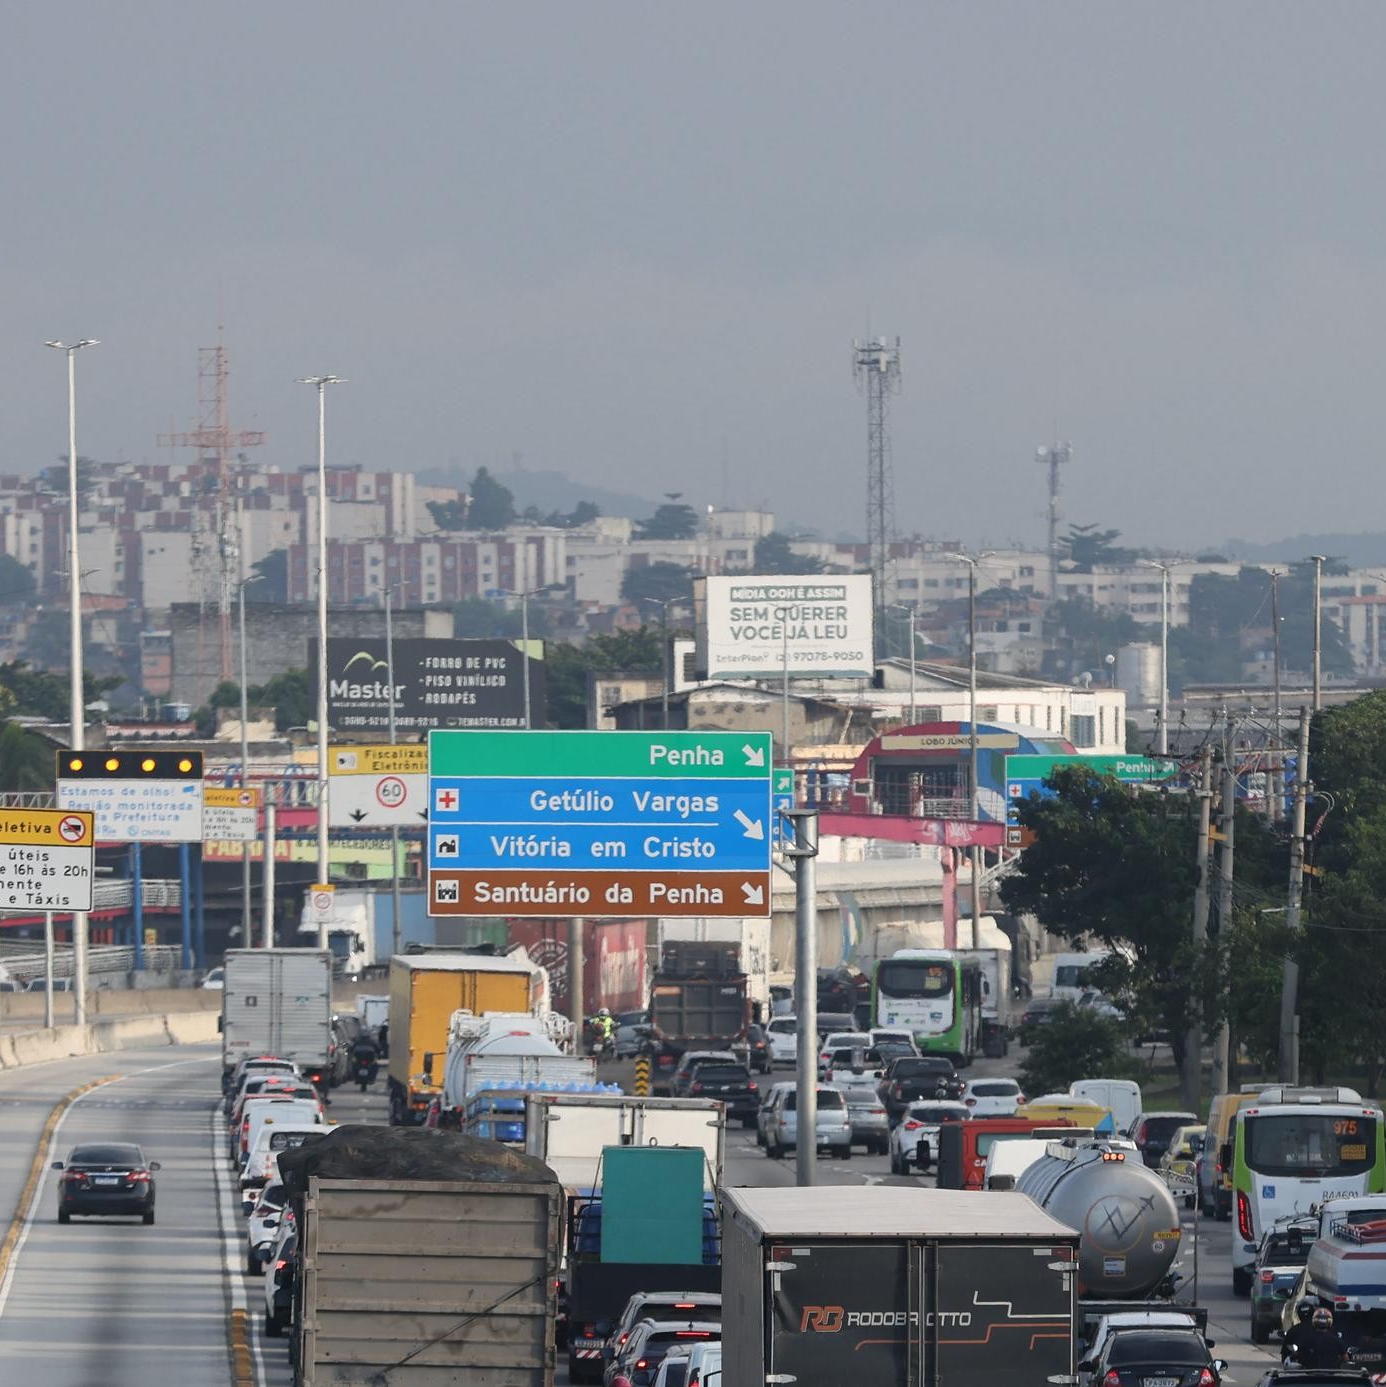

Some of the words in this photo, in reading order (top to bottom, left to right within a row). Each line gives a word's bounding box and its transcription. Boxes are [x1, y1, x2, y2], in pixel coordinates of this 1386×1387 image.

[806, 587, 845, 599] ASSIM
[730, 607, 768, 622] SEM
[774, 605, 848, 623] QUERER
[729, 622, 783, 640] VOCÊ
[786, 622, 810, 640] JÁ
[814, 625, 848, 640] LEU
[466, 657, 481, 669] DE
[484, 657, 507, 669] PVC
[329, 679, 406, 700] Master
[921, 738, 946, 746] LOBO
[650, 744, 725, 766] Penha
[121, 786, 136, 796] de
[382, 785, 402, 798] 60
[117, 801, 194, 811] monitorada
[530, 789, 615, 812] Getúlio
[632, 790, 720, 819] Vargas
[113, 812, 181, 822] Prefeitura
[490, 833, 571, 858] Vitória
[590, 839, 627, 858] em
[643, 836, 716, 859] Cristo
[8, 848, 50, 862] úteis
[0, 866, 6, 875] e
[14, 863, 34, 876] 16h
[41, 864, 56, 876] às
[63, 865, 89, 878] 20h
[9, 895, 17, 904] e
[25, 892, 70, 905] Táxis
[473, 880, 591, 904] Santuário
[604, 882, 633, 904] da
[649, 882, 724, 904] Penha
[1333, 1120, 1358, 1136] 975
